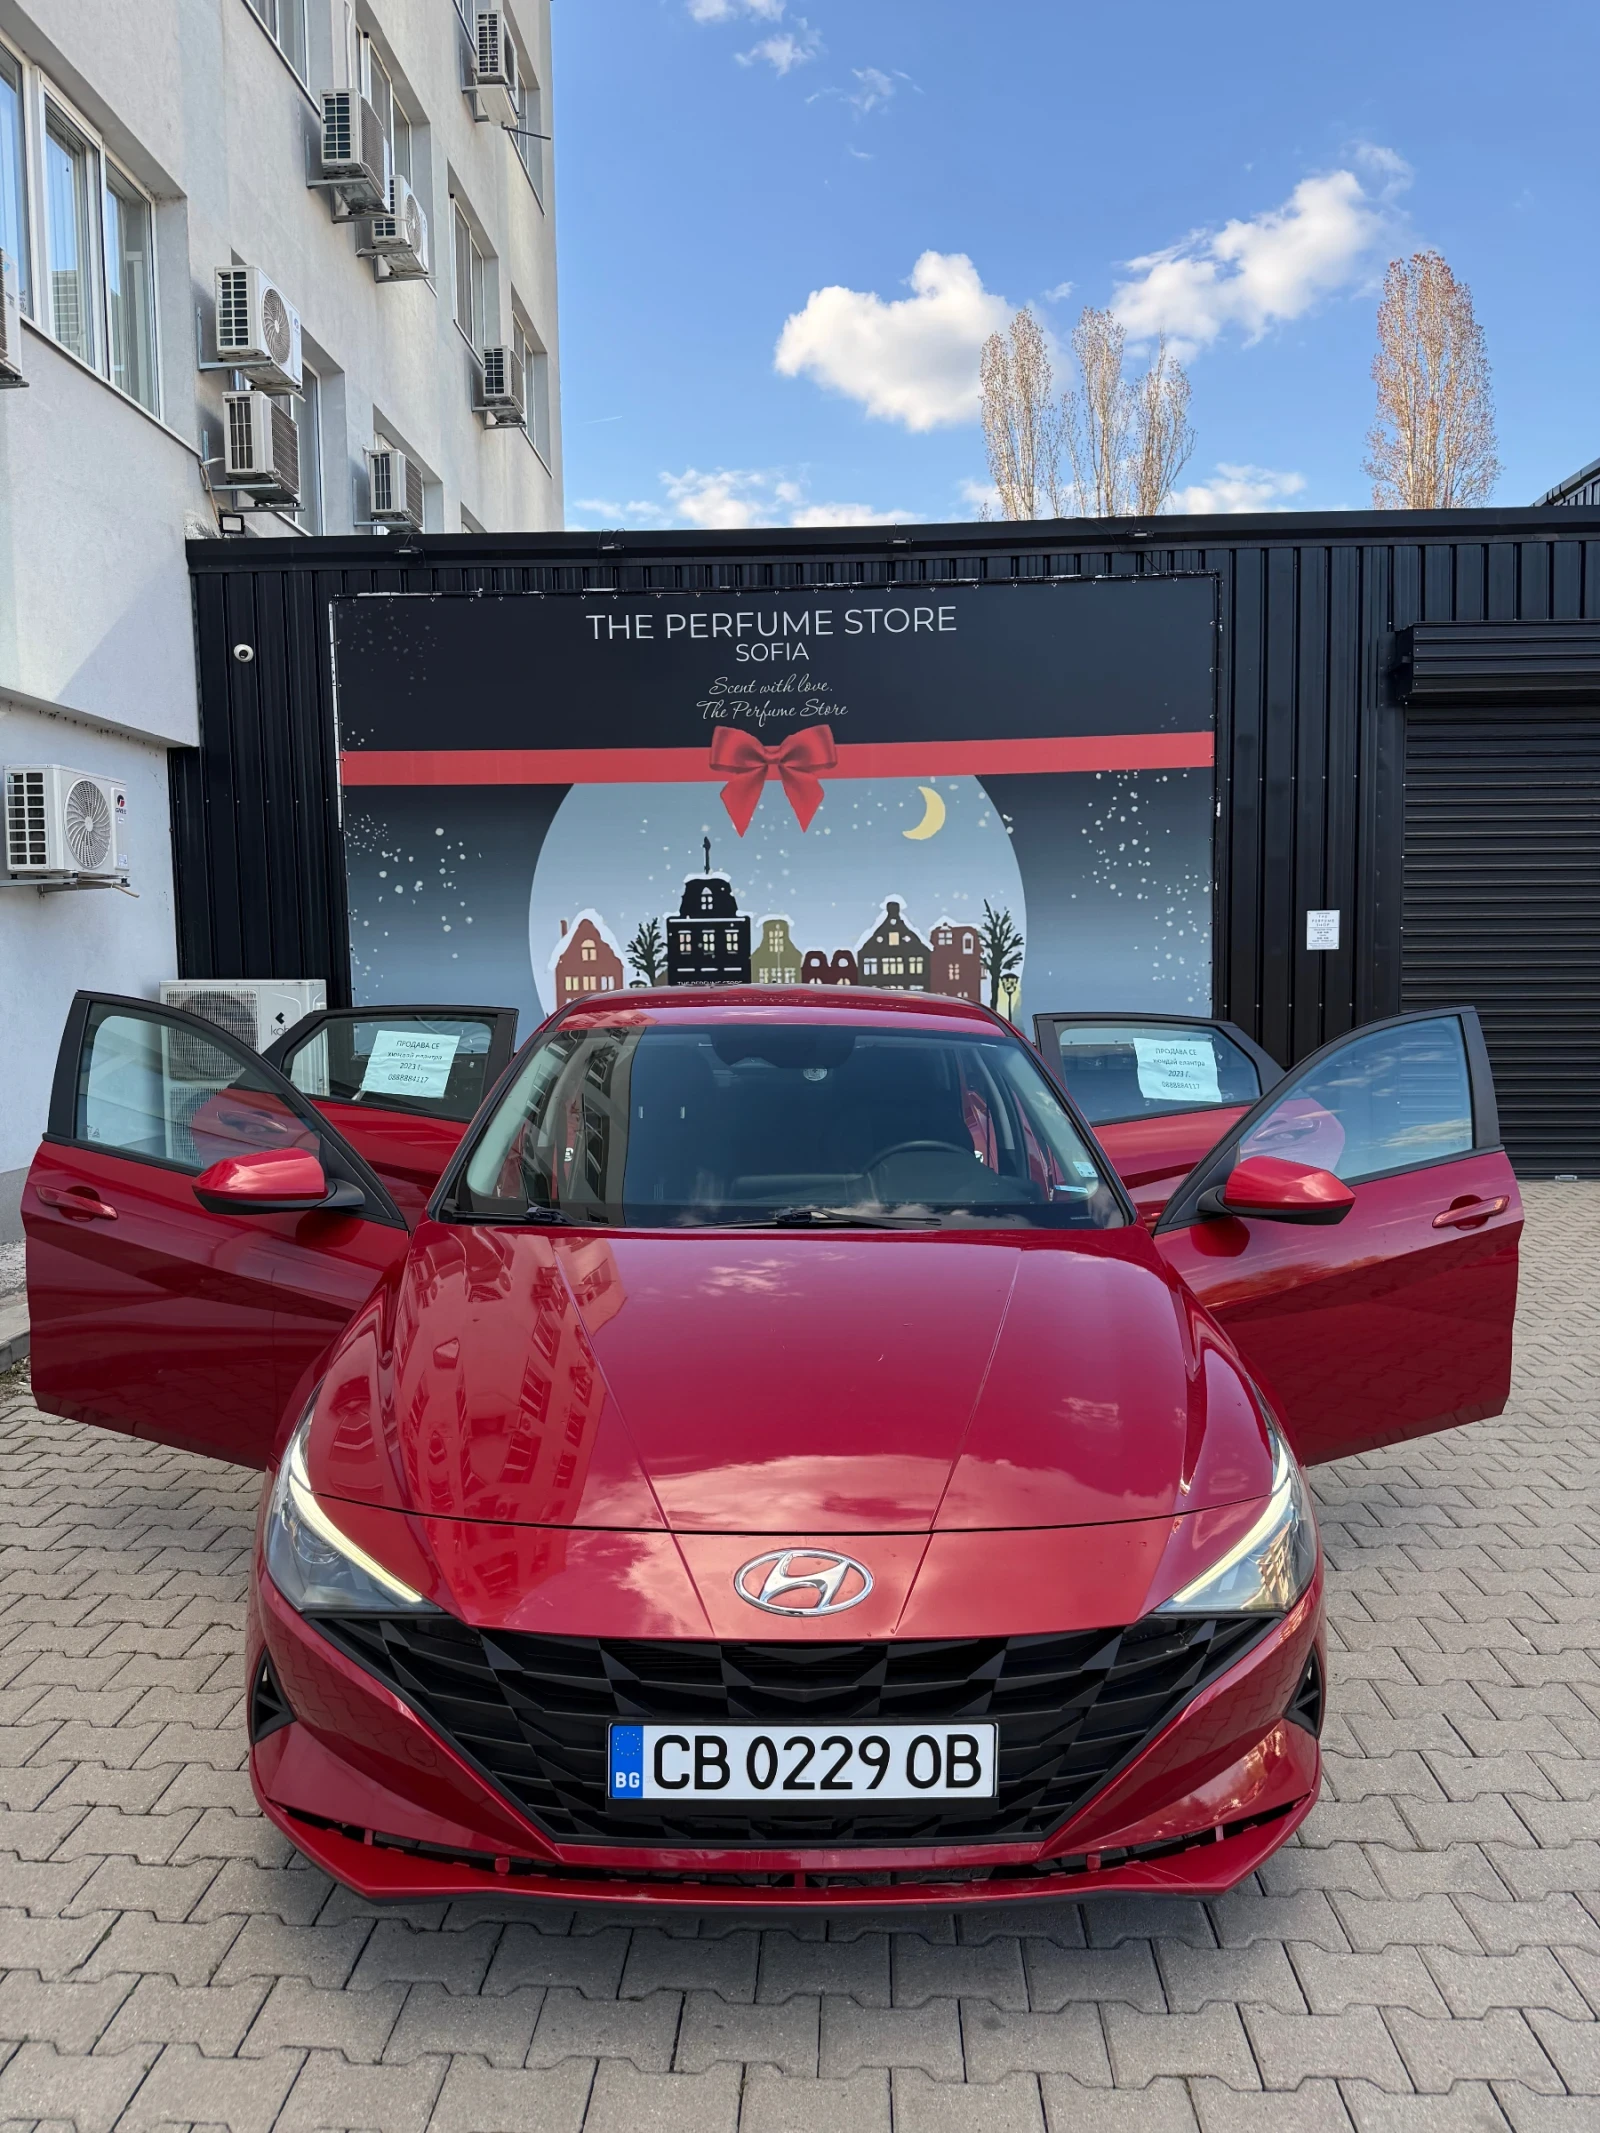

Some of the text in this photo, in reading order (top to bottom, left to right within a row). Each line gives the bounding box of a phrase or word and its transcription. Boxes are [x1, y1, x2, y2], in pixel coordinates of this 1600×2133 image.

[586, 605, 957, 640] THE PERFUME STORE
[736, 642, 810, 662] SOFIA
[708, 673, 834, 696] Scent with love.
[696, 698, 849, 727] The Perfume Store
[396, 1040, 430, 1049] ПРОДАВА
[1155, 1047, 1188, 1055] ПРОДАВА
[399, 1062, 416, 1070] 2023
[653, 1734, 731, 1790] CB
[745, 1735, 891, 1790] 0229
[615, 1771, 641, 1789] BG
